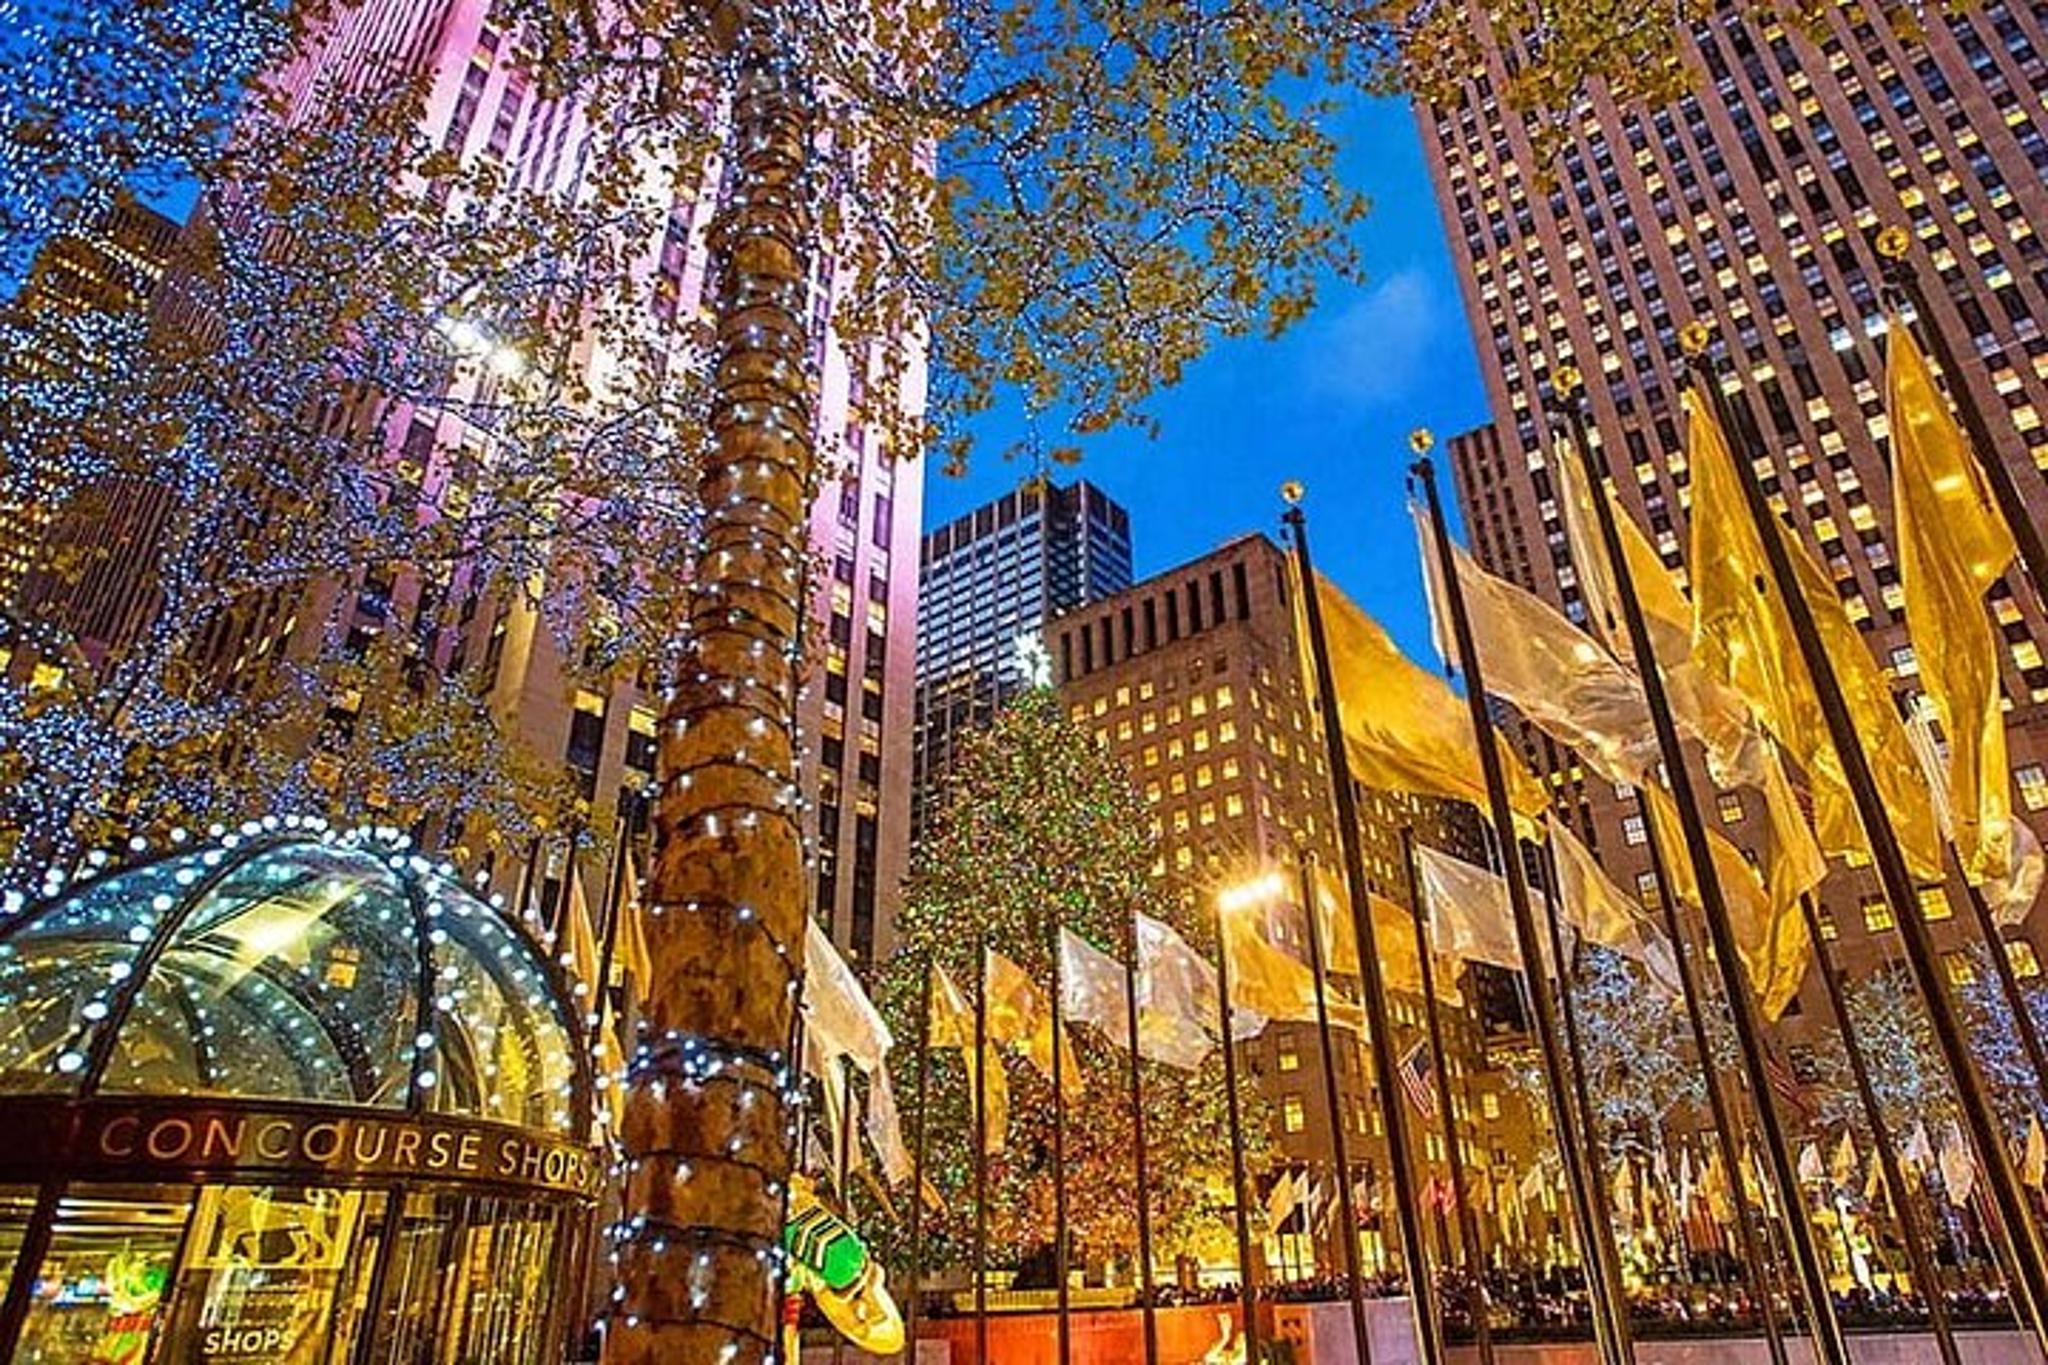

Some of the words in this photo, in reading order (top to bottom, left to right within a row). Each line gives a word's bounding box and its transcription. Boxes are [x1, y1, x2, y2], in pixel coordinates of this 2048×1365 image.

[101, 1116, 482, 1170] CONCOURSE
[499, 1140, 588, 1188] SHOPS
[203, 1328, 295, 1354] SHOPS
